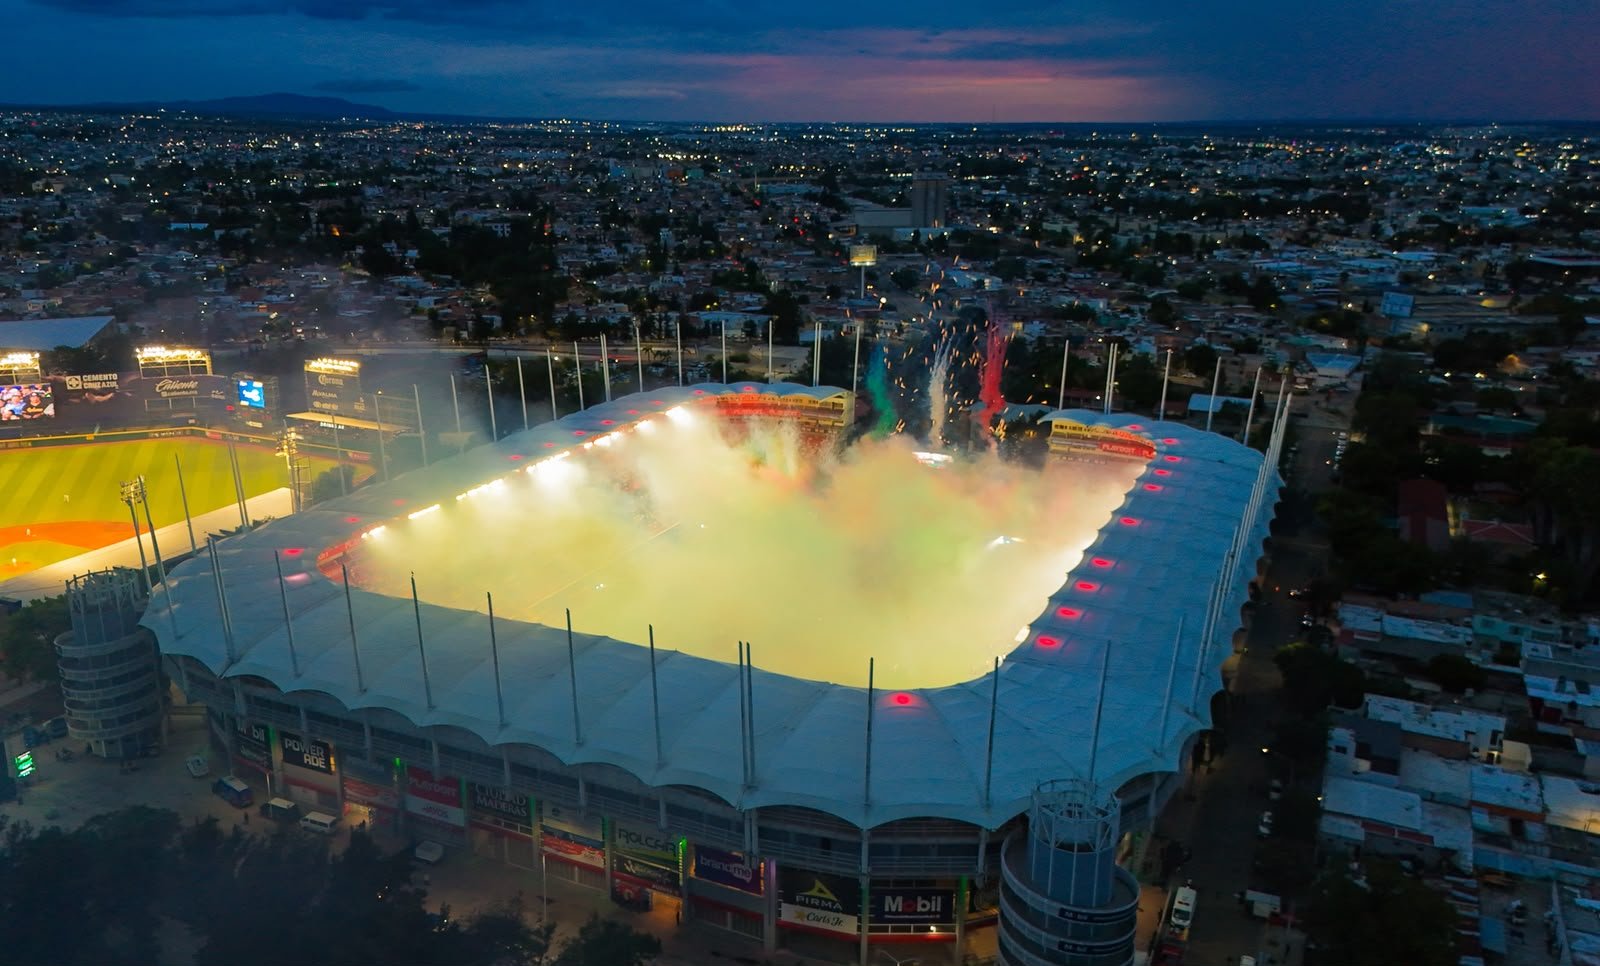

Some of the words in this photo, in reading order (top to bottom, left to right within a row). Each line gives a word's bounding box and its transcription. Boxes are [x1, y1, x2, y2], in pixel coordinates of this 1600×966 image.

[82, 373, 118, 382] CEMENTO
[155, 378, 199, 393] Caliente
[318, 374, 344, 386] Corona
[285, 737, 324, 758] POWER
[304, 753, 326, 769] ADE
[476, 792, 527, 817] MADERAS
[795, 895, 843, 911] PIRMA
[883, 895, 942, 913] Mobil
